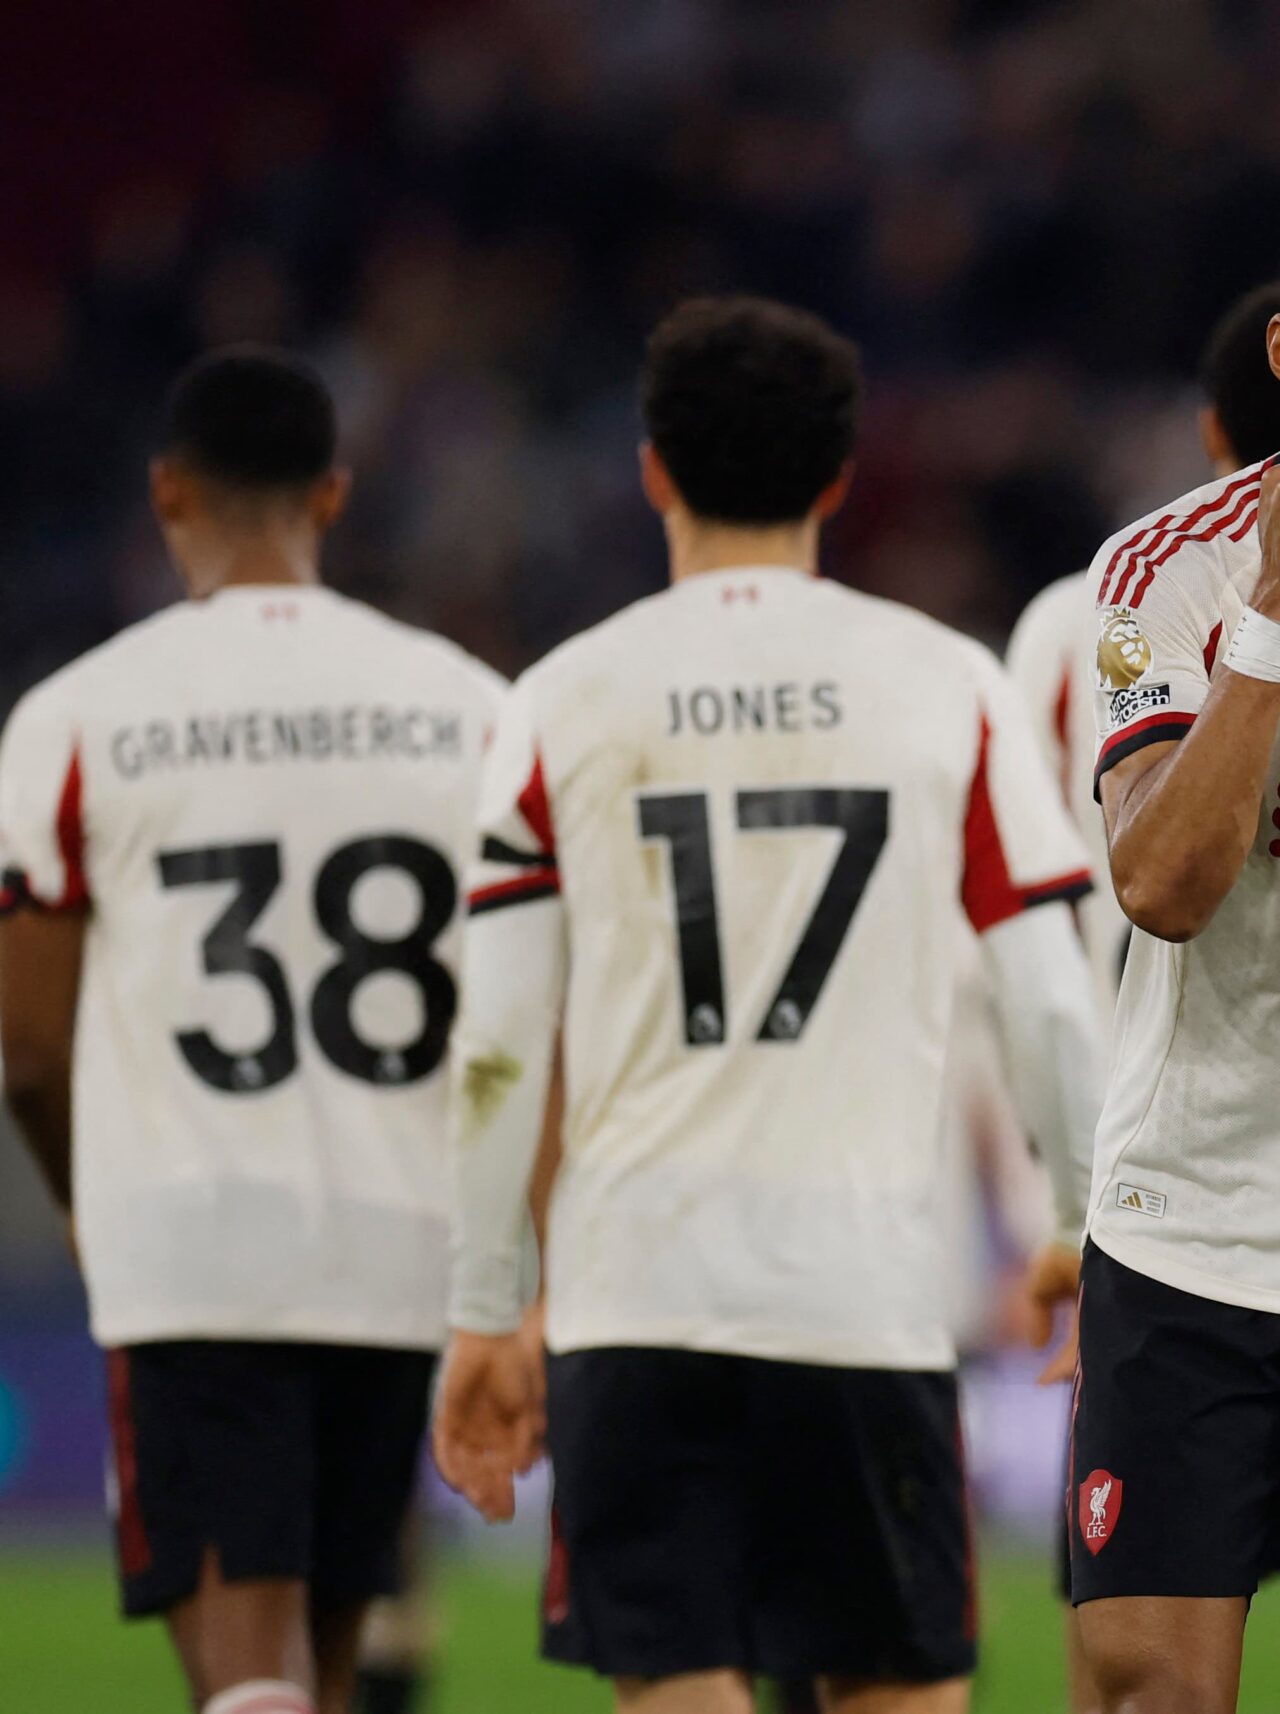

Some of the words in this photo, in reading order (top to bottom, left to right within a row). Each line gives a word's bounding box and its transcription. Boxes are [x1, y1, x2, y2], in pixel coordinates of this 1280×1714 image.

[111, 704, 462, 779] GRAVENBERCH
[667, 683, 842, 735] JONES
[1119, 694, 1170, 723] racism
[637, 788, 891, 1046] 17
[155, 833, 460, 1093] 38
